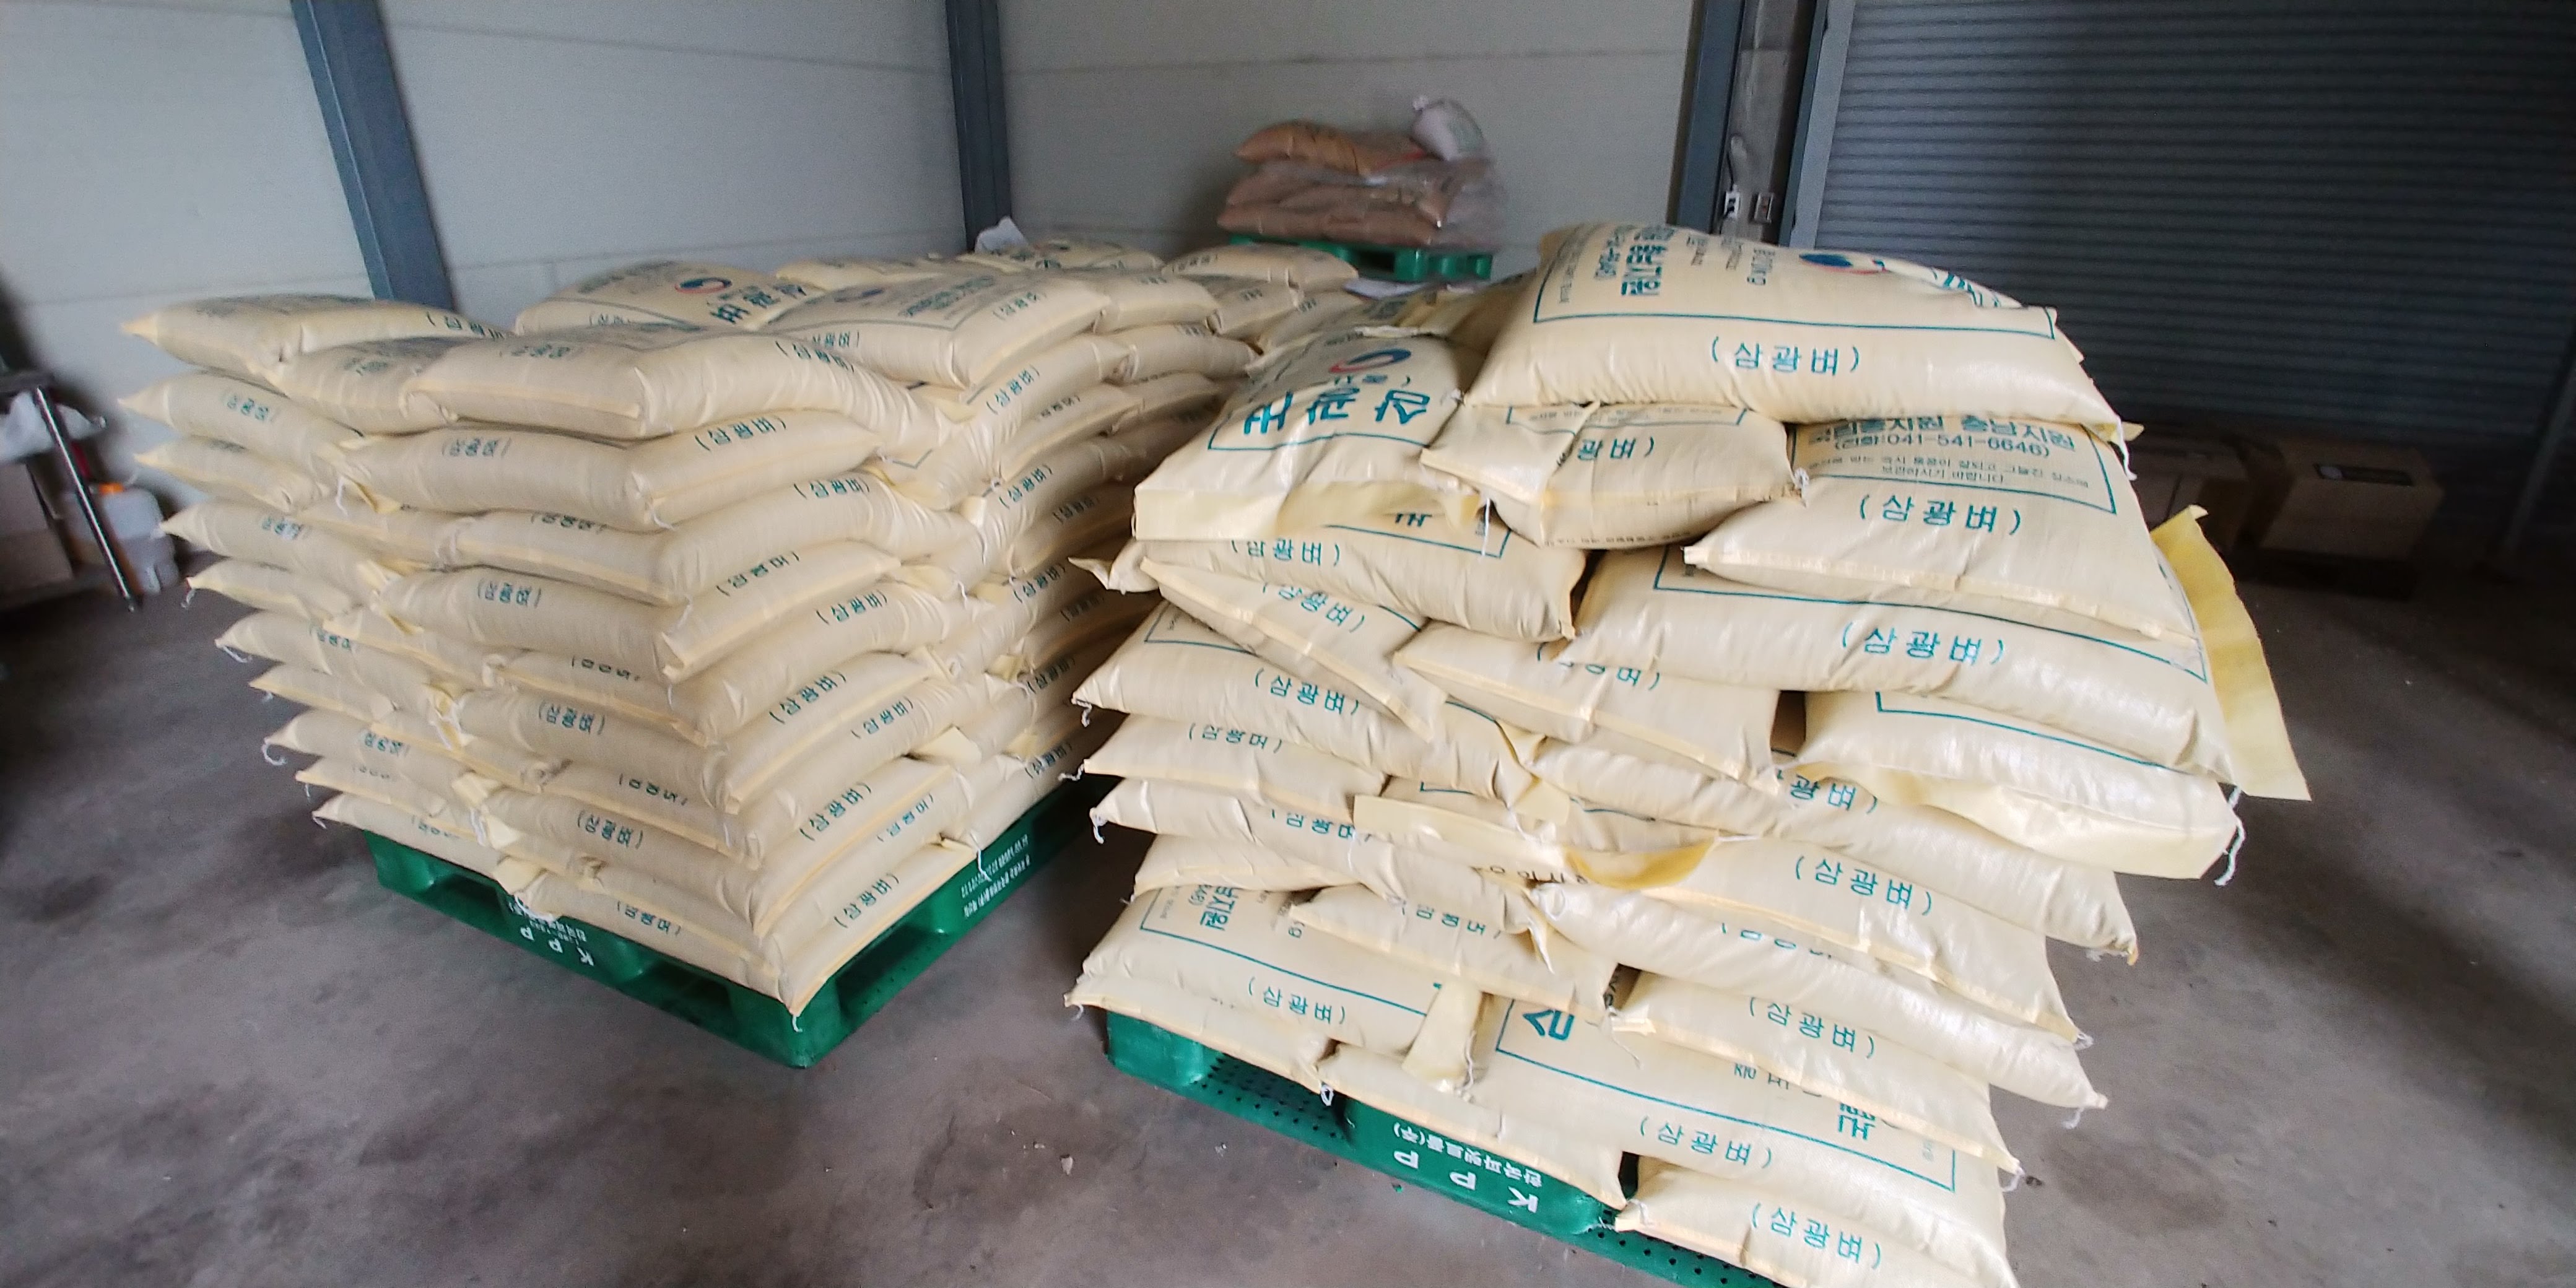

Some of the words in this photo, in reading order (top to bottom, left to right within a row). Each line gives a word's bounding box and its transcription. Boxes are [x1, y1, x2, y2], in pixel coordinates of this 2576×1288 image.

[1711, 336, 1860, 376] (삼광벼)
[1577, 436, 1655, 461] 광벼)
[1858, 491, 2022, 536] (삼광벼)
[1842, 619, 2004, 665] (삼광벼)
[1254, 667, 1360, 716] (삼광벼)
[1777, 770, 1878, 814] 광벼)
[1795, 856, 1933, 916] (삼광벼)
[1247, 976, 1346, 1025] (삼광벼)
[1749, 997, 1876, 1060] (삼광벼)
[1638, 1116, 1773, 1169] (삼광벼)
[1751, 1202, 1881, 1270] (삼광벼)
